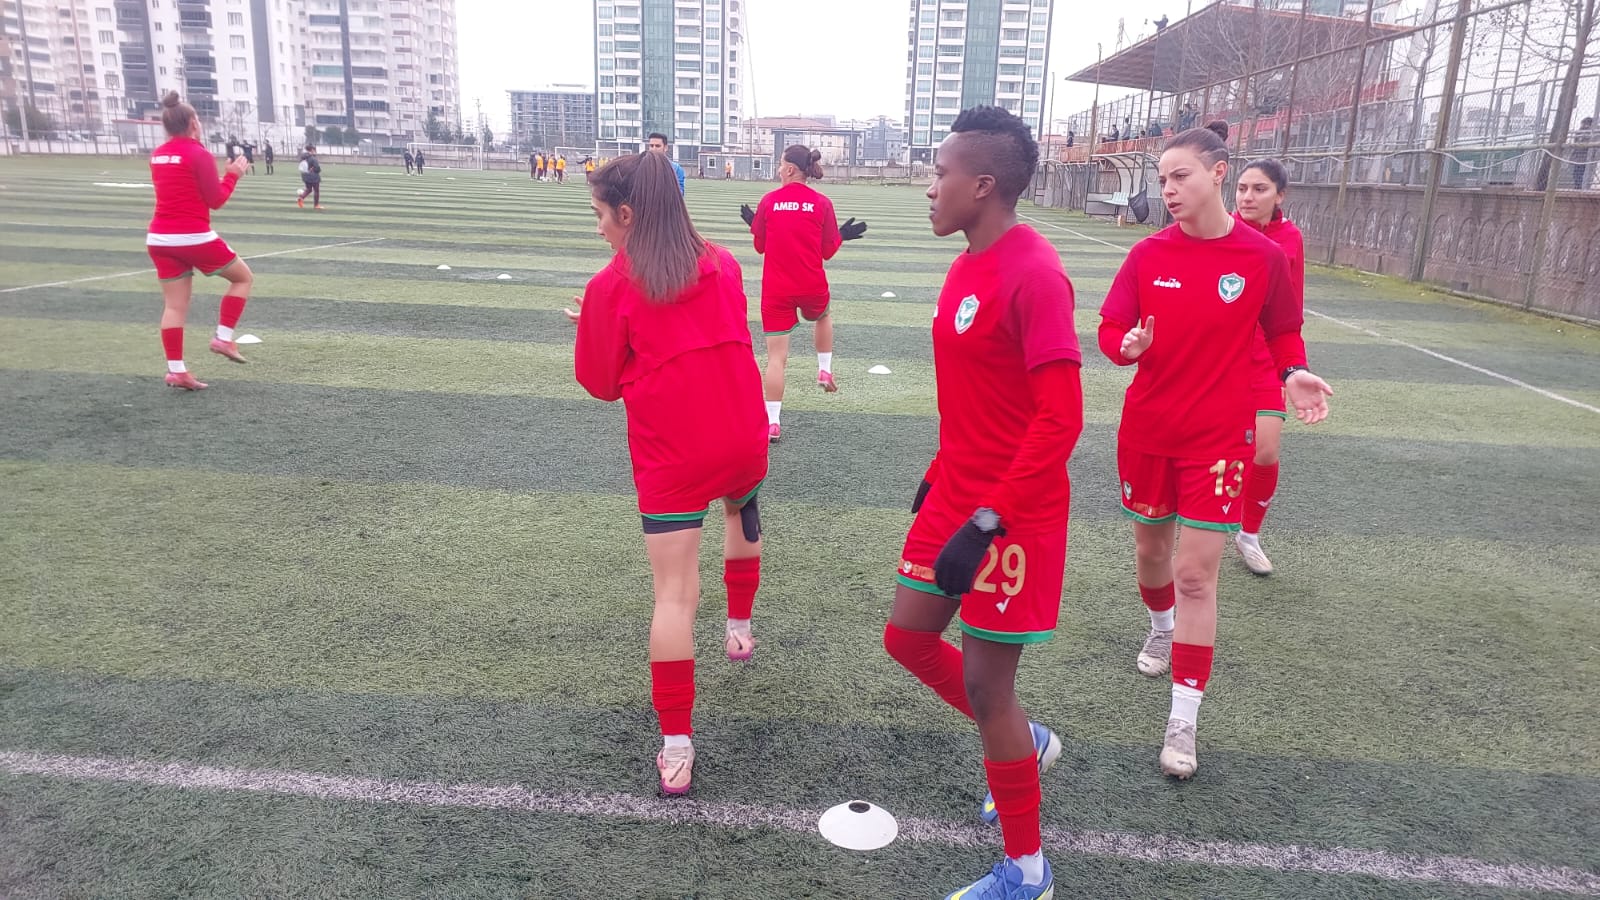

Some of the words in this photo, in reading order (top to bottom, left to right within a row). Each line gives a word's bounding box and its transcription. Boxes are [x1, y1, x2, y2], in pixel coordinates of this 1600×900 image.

[773, 201, 799, 212] AMED
[802, 202, 815, 212] SK
[1209, 459, 1245, 498] 13
[973, 543, 1026, 596] 29
